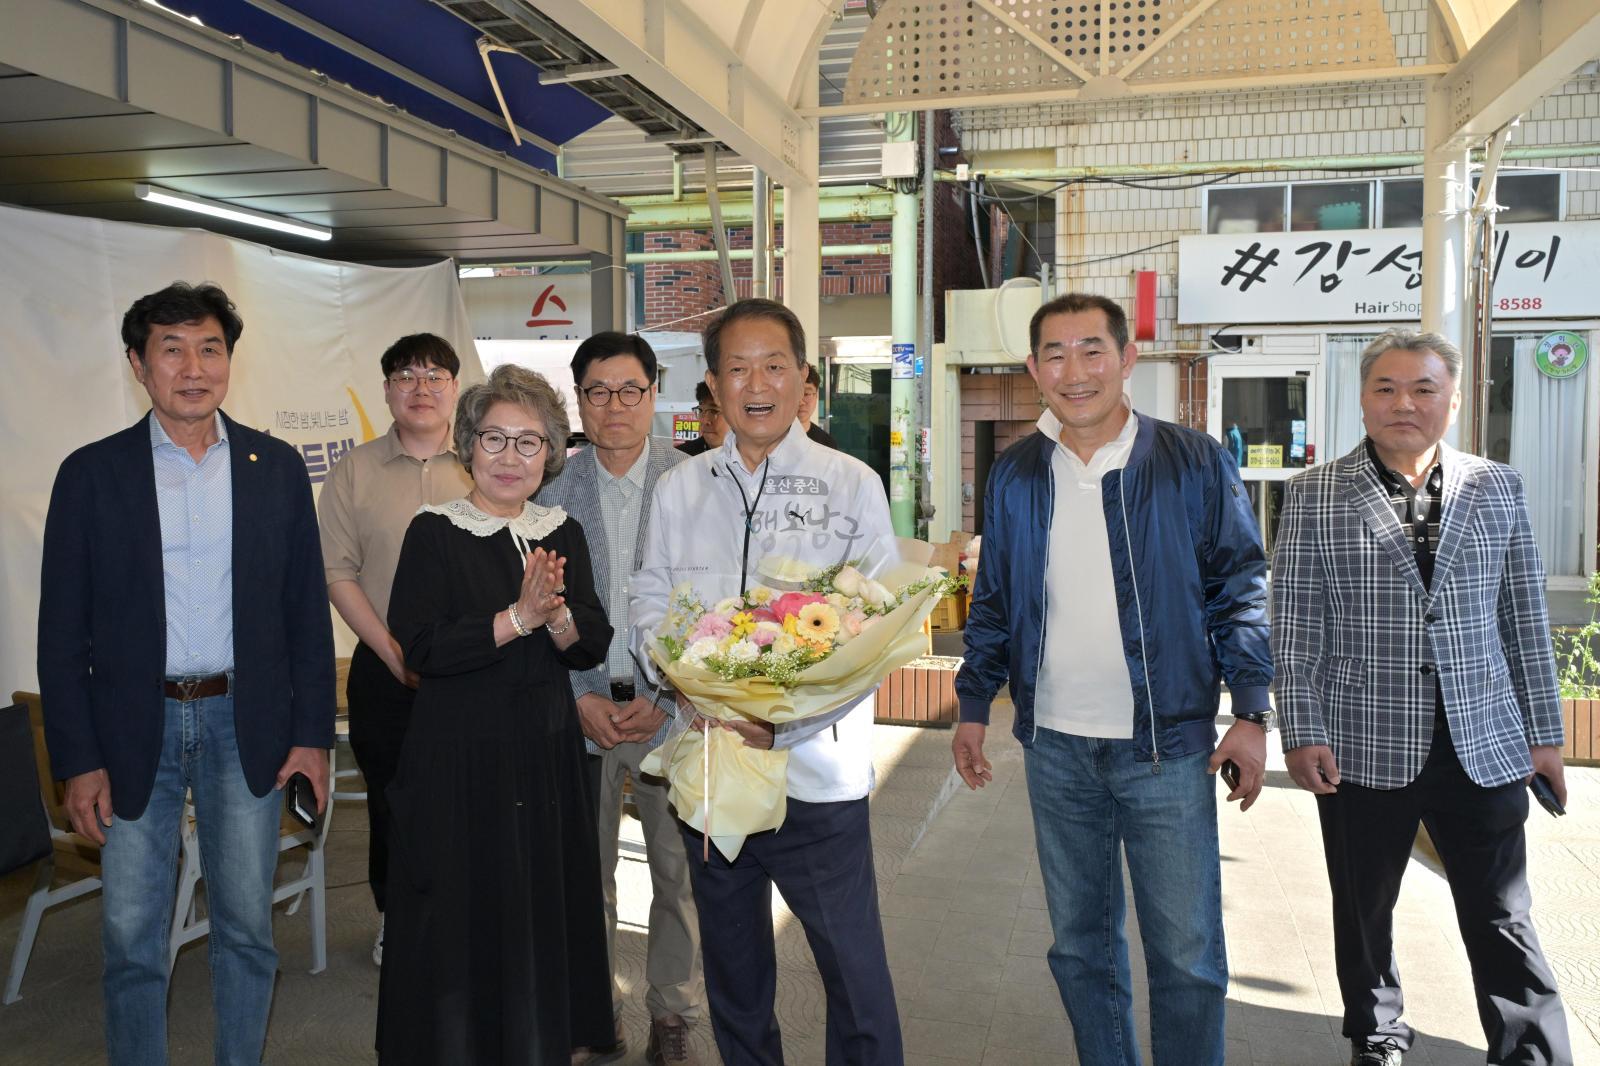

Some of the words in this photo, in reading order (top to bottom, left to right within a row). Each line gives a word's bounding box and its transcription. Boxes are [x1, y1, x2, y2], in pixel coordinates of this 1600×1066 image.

[1355, 301, 1390, 314] Hair
[764, 478, 792, 494] 울산
[793, 478, 820, 494] 중심
